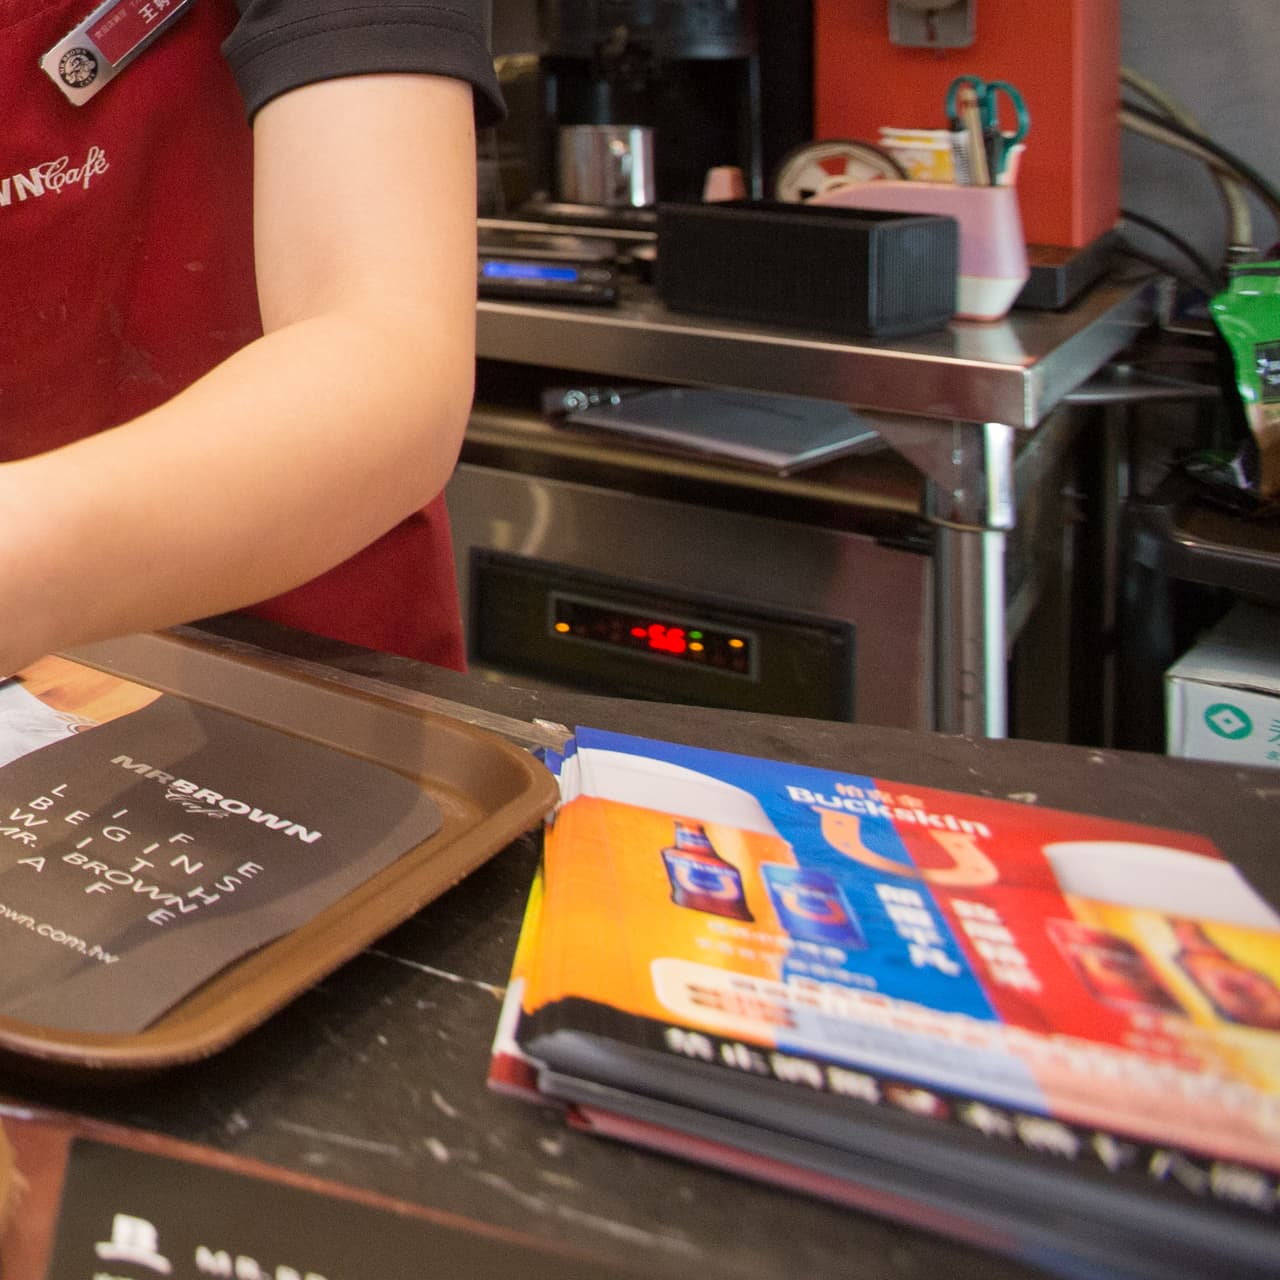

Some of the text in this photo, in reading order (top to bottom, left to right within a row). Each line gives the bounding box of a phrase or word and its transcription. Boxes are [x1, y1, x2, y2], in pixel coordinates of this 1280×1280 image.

[110, 754, 322, 845] MRBROWN
[785, 785, 992, 839] Buckskin
[61, 851, 200, 916] BROWN
